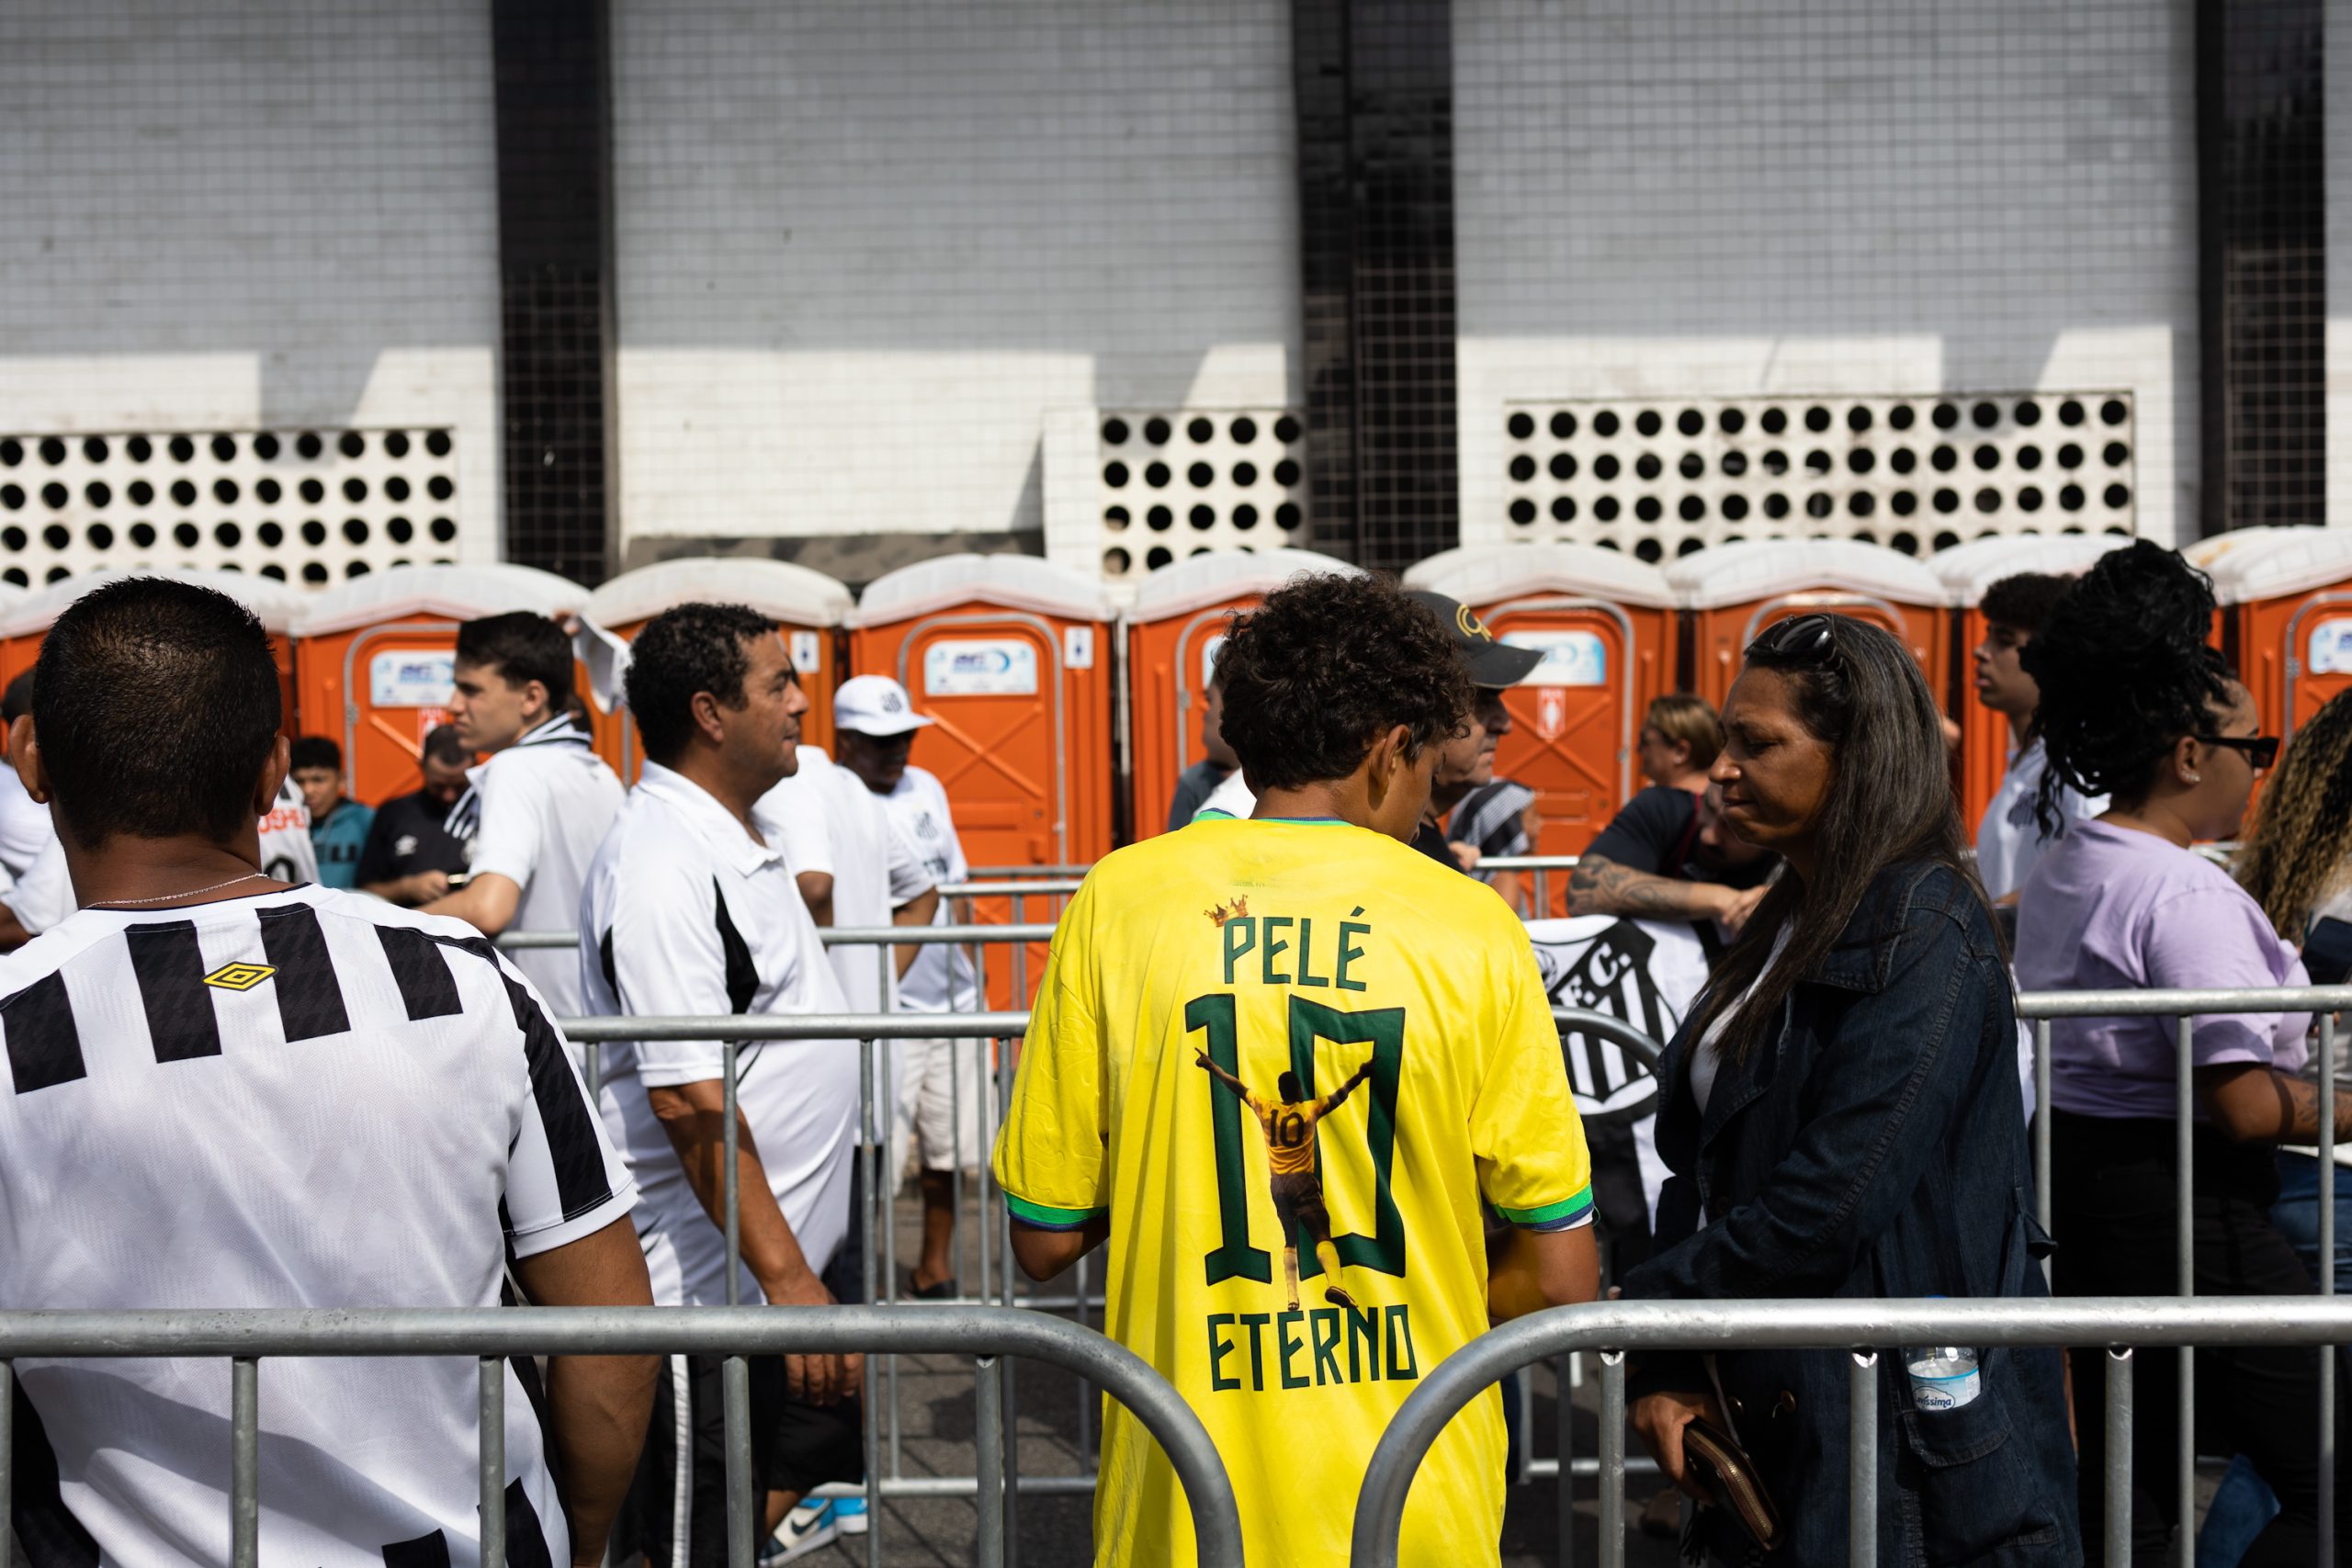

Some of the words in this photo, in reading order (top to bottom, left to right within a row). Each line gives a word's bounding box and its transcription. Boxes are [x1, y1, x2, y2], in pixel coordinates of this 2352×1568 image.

[1224, 906, 1372, 992] PELÉ
[1184, 992, 1407, 1286] 10
[1269, 1108, 1305, 1148] 10
[1207, 1303, 1419, 1393] ETERNO
